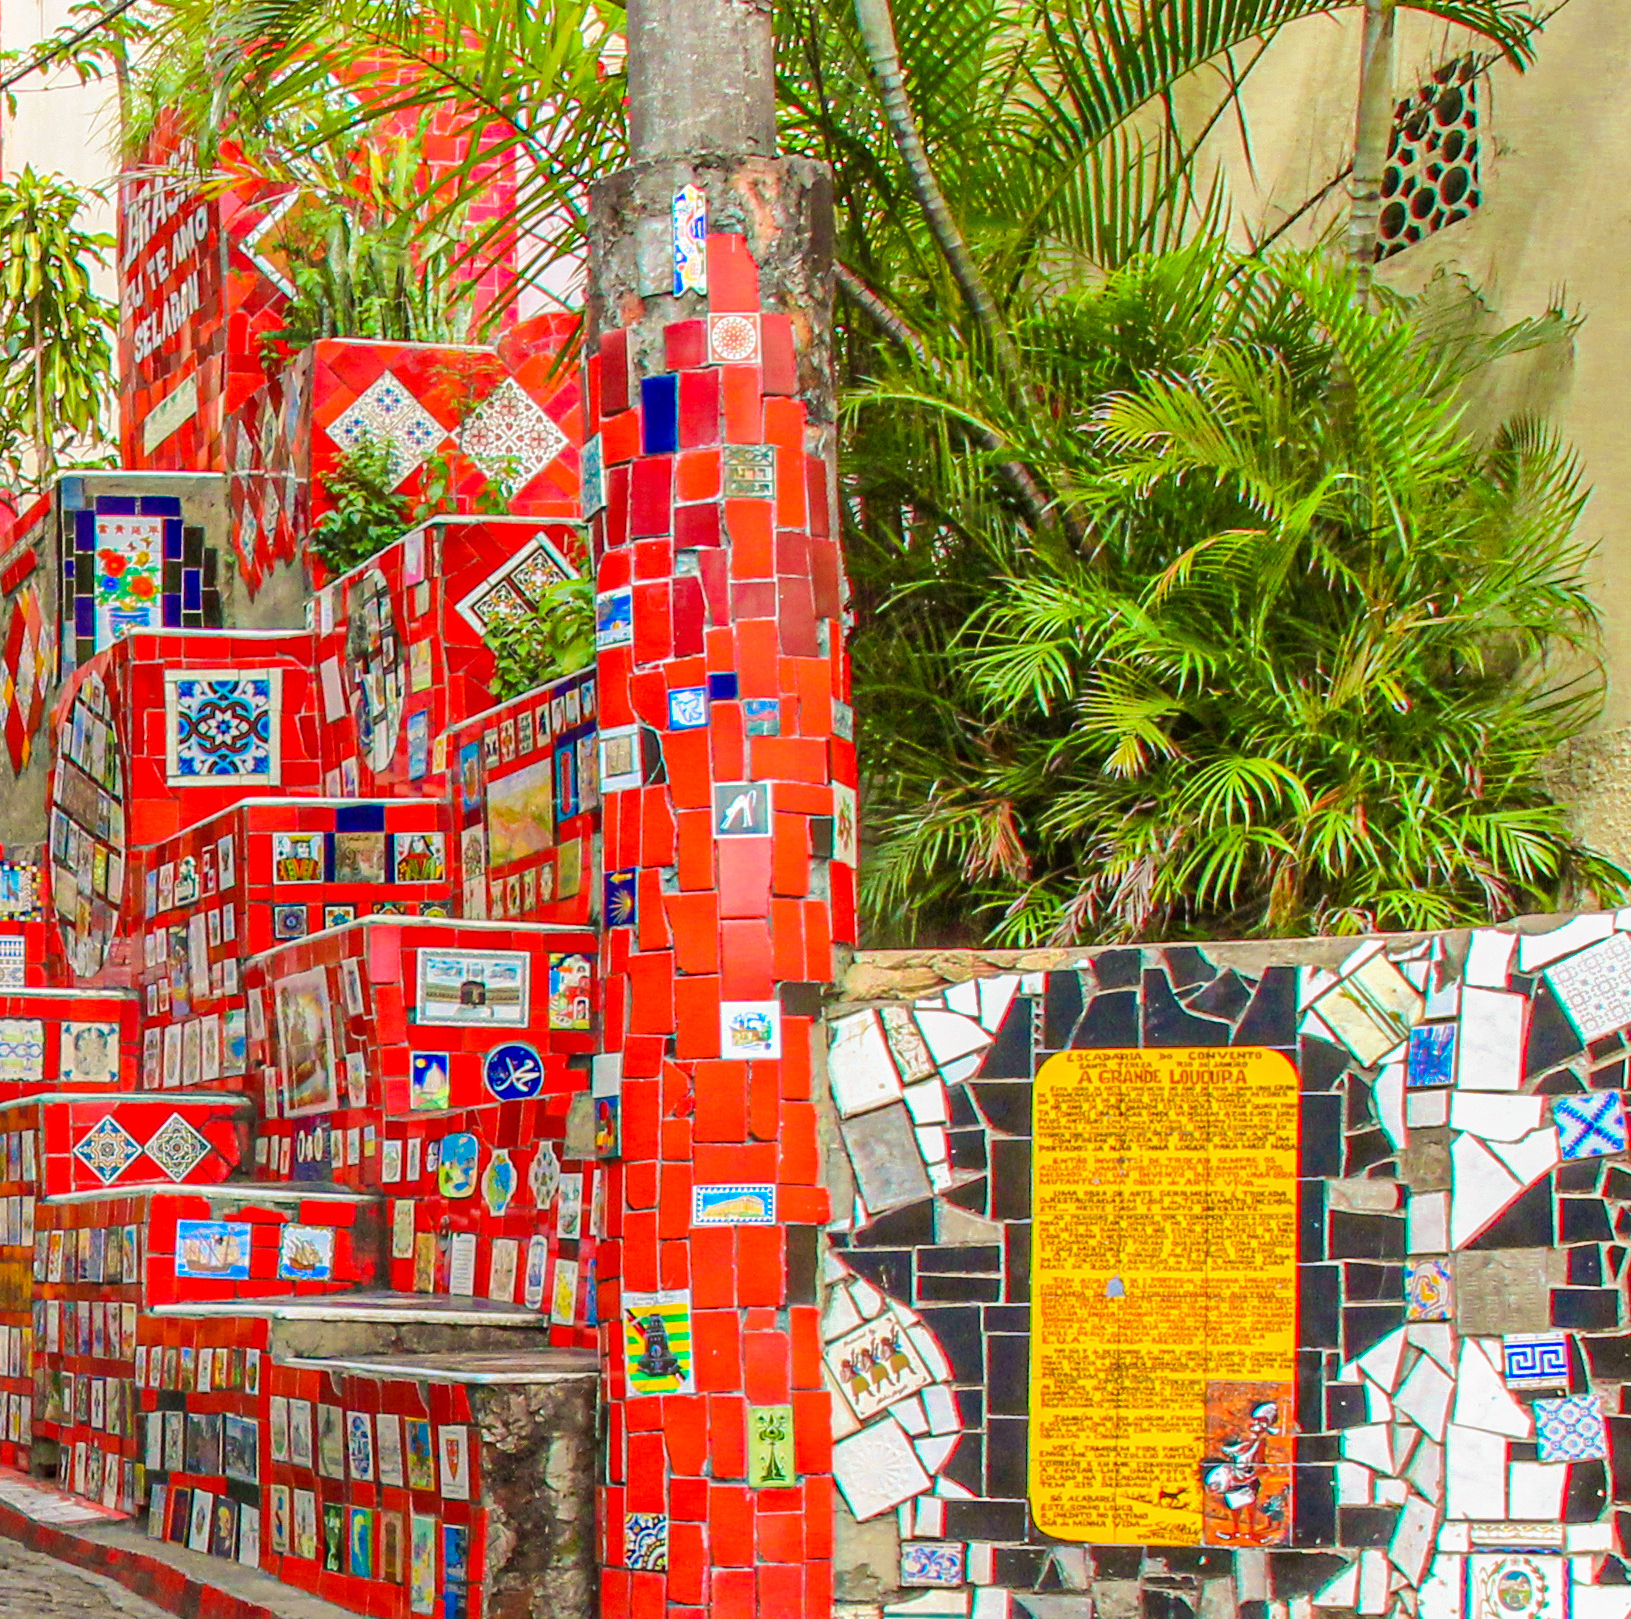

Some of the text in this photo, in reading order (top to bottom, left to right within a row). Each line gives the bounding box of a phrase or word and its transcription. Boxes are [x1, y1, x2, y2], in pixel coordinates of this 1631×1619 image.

[172, 203, 208, 270] AMO
[1066, 1051, 1263, 1063] ESCADARIA CONVENTO
[1078, 1062, 1108, 1070] SANTA
[1176, 1060, 1194, 1068] RIO
[1213, 1060, 1249, 1068] JANEIRO
[1077, 1069, 1248, 1085] A GRANDE LOUCURA
